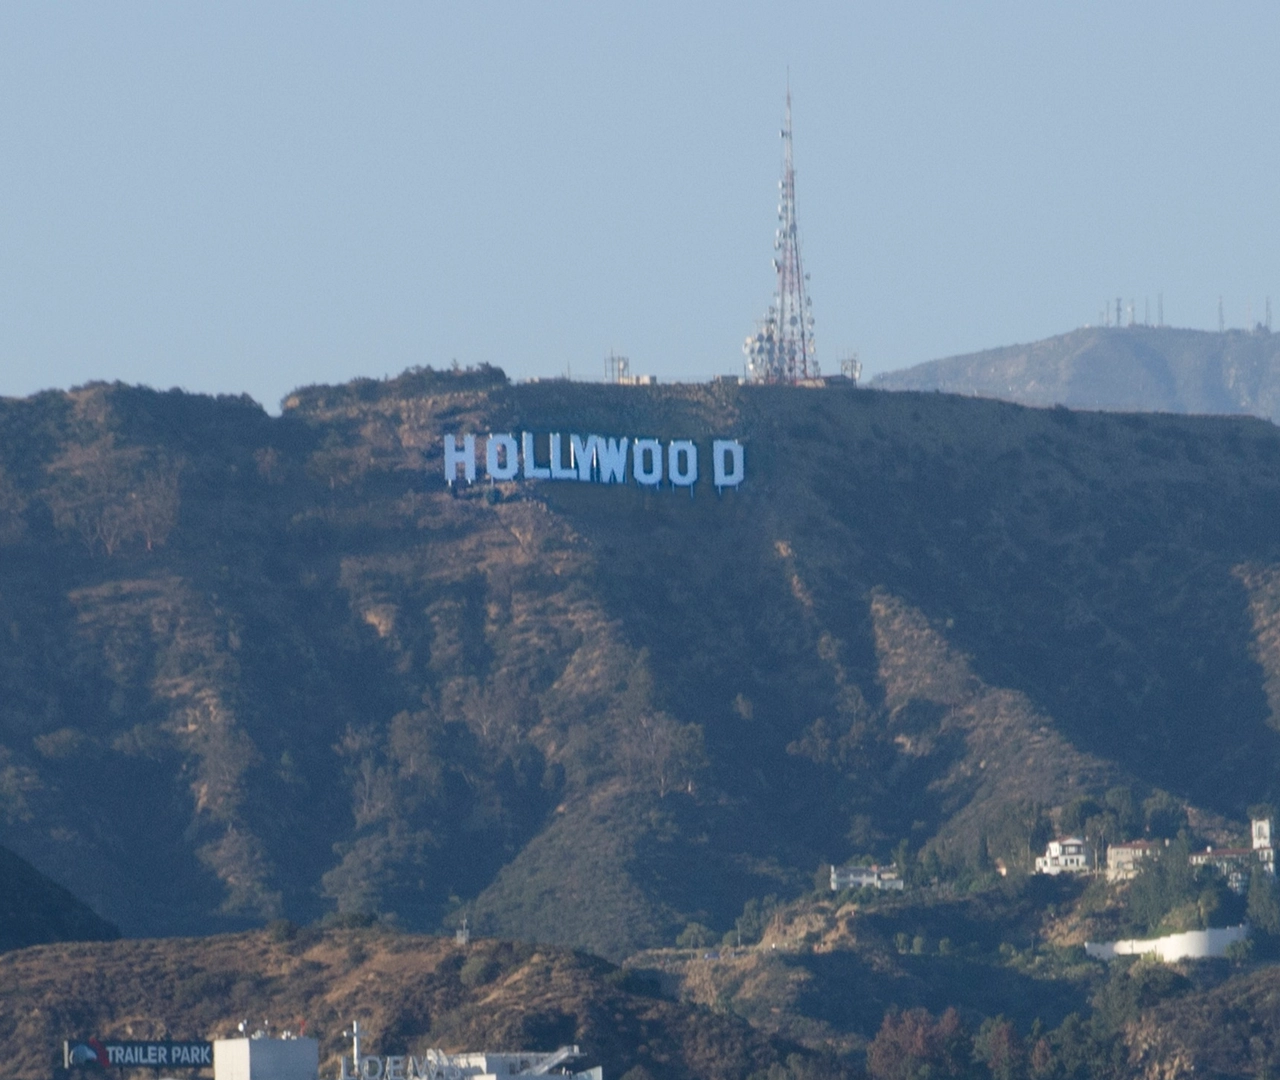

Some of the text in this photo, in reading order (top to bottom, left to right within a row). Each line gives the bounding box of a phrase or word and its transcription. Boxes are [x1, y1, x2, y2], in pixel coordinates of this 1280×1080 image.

[443, 432, 744, 486] HOLLYWOOD
[106, 1045, 211, 1063] TRAILER PARK
